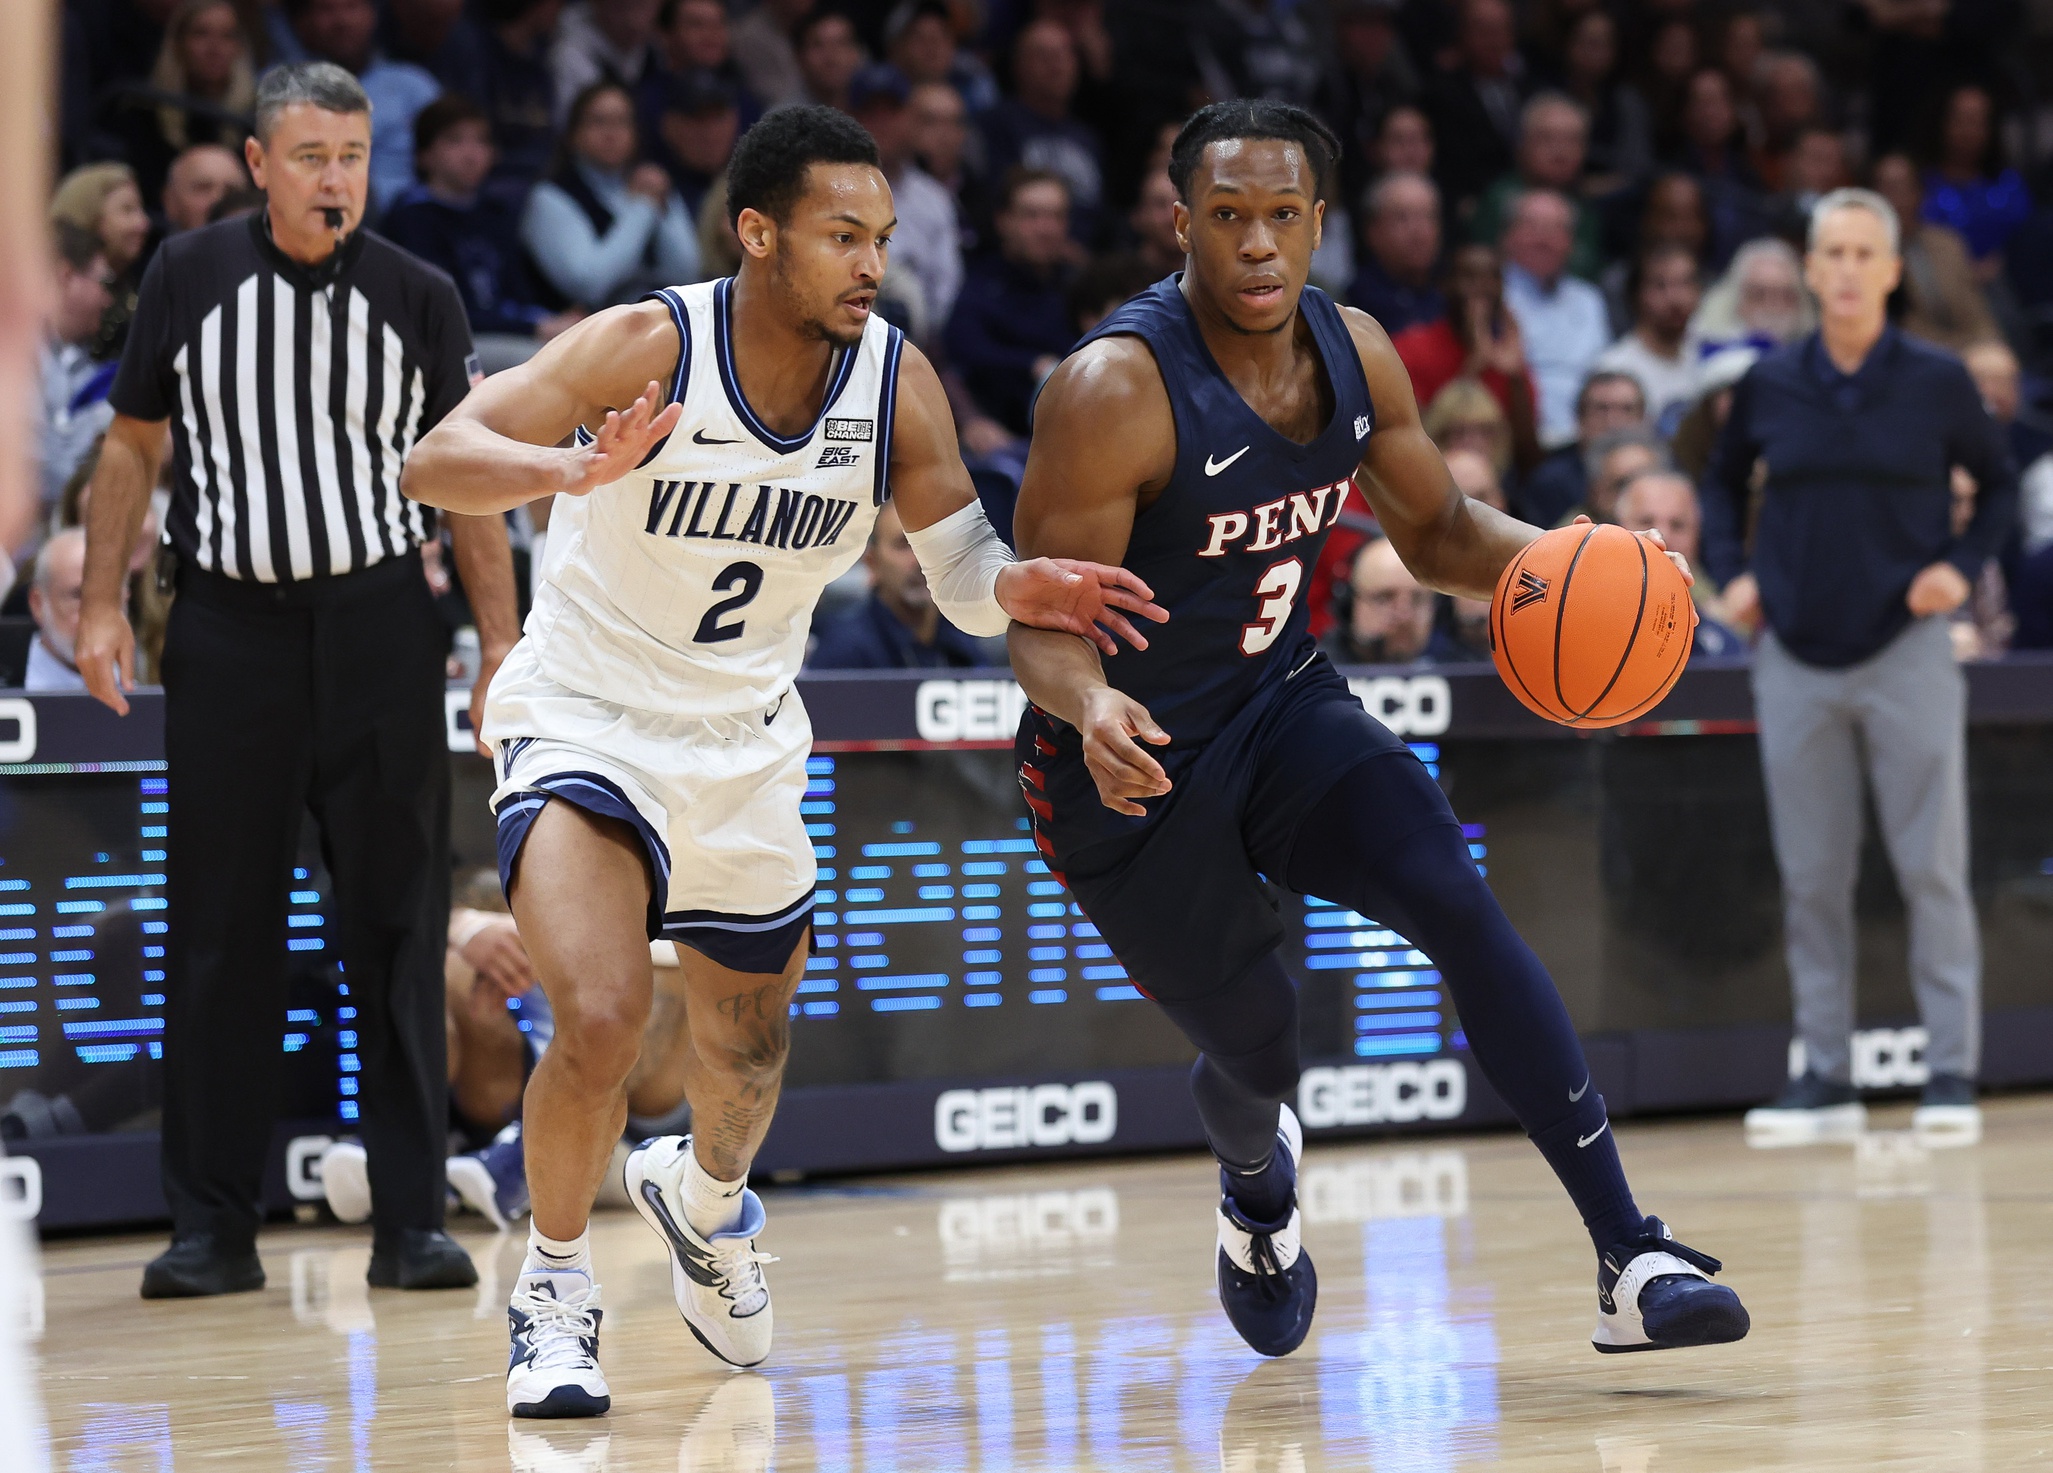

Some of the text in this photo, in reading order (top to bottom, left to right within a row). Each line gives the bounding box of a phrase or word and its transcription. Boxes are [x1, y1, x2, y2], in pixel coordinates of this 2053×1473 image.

[818, 456, 860, 464] EAST
[822, 447, 852, 455] BIG
[827, 431, 871, 440] CHANGE
[692, 561, 764, 643] 2
[1238, 555, 1303, 657] 3
[935, 1081, 1117, 1152] GEICO
[1297, 1059, 1468, 1129] GEICO
